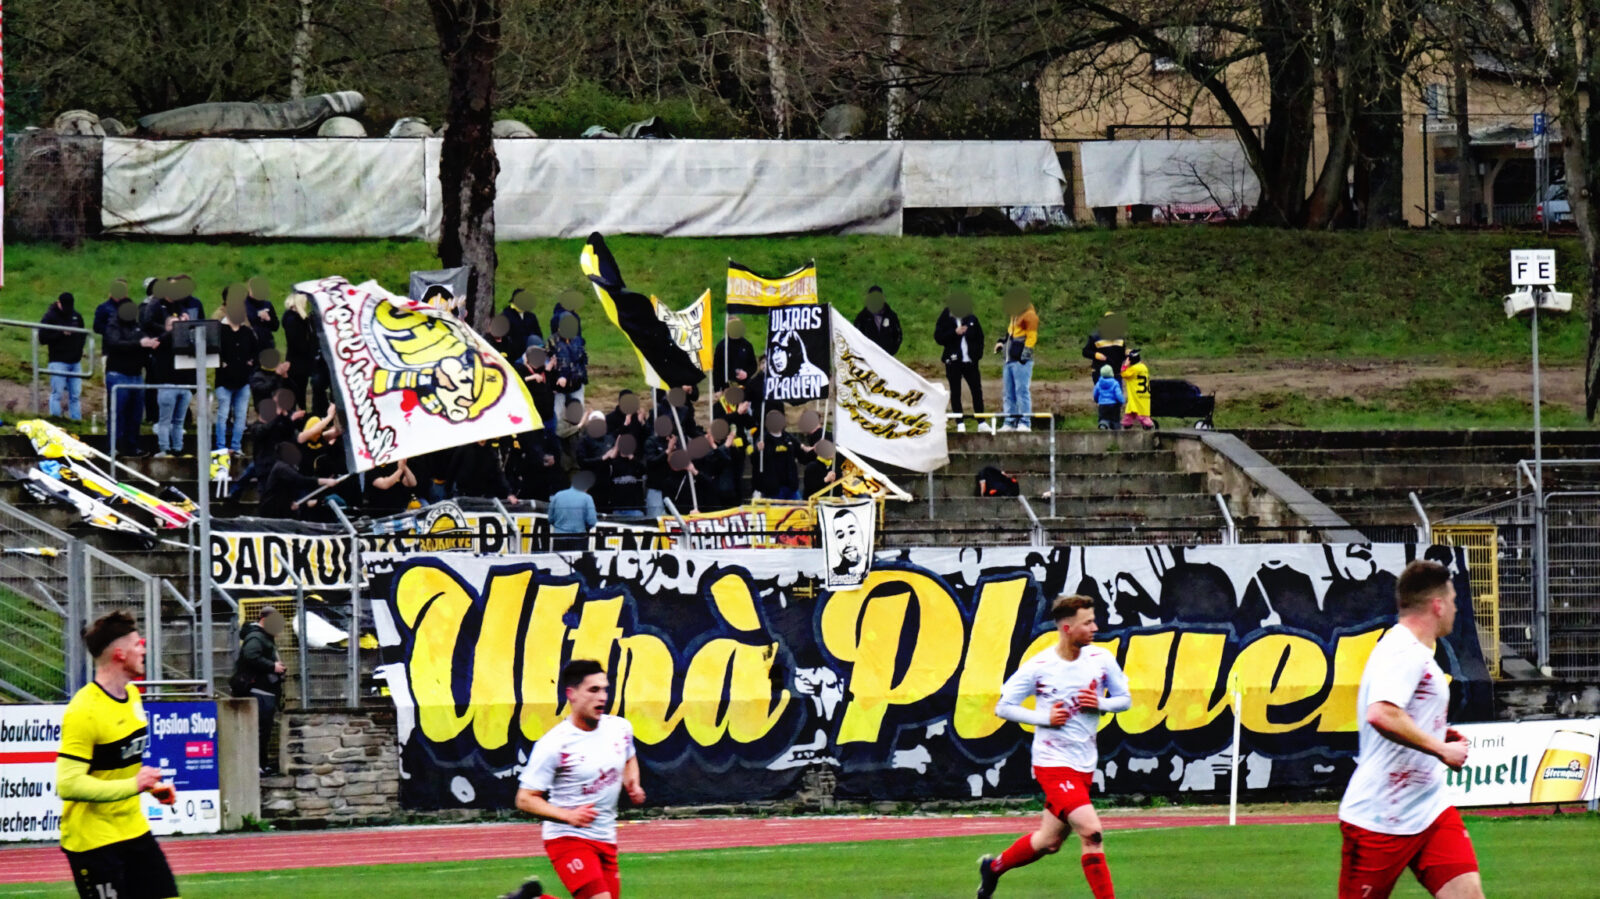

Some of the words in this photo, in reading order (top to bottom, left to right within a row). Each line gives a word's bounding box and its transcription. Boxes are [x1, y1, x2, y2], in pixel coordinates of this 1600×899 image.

[1518, 262, 1528, 279] F
[1538, 262, 1550, 279] E
[771, 307, 822, 332] ULTRAS
[765, 375, 821, 400] PLAUEN
[153, 712, 189, 740] Epsilon
[191, 712, 216, 739] Shop
[1482, 736, 1505, 748] mit
[567, 858, 584, 874] 10
[96, 883, 118, 899] 14
[1361, 885, 1373, 898] 7
